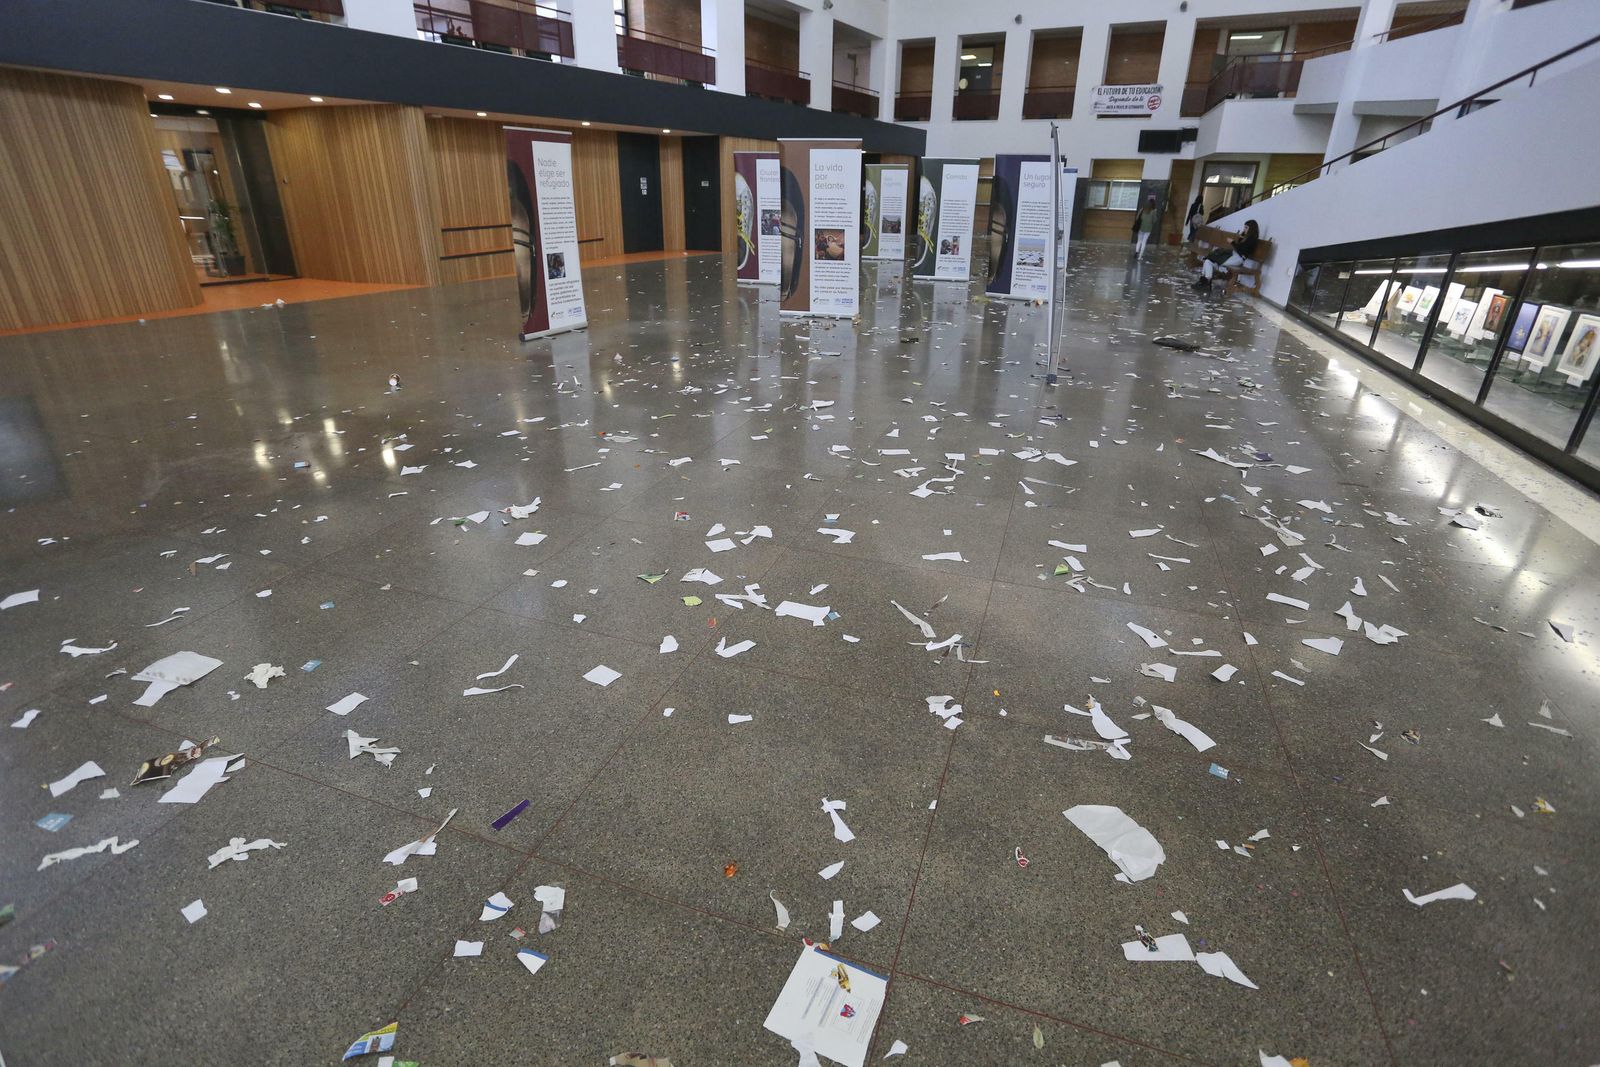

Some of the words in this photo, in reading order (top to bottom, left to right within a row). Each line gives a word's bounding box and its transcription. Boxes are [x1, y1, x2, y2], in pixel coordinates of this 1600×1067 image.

[538, 158, 557, 167] Nadie
[539, 170, 555, 179] elige
[540, 180, 569, 190] refugiado
